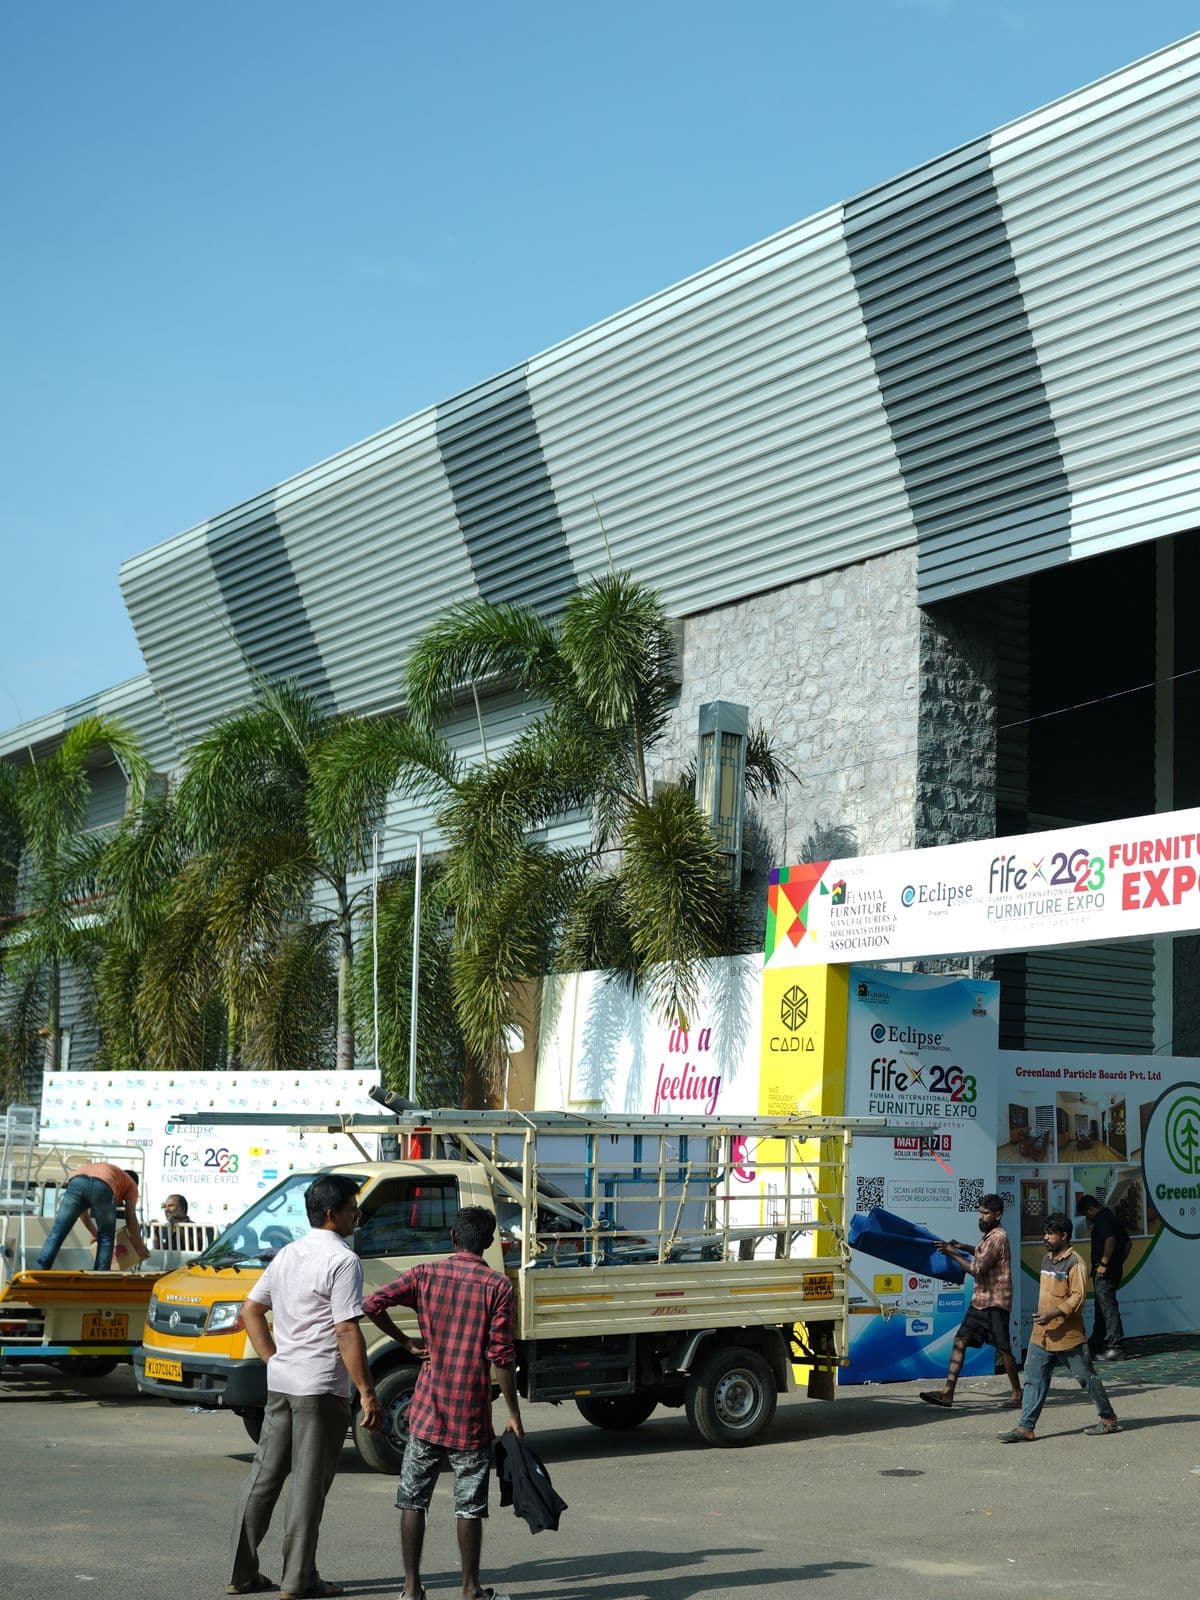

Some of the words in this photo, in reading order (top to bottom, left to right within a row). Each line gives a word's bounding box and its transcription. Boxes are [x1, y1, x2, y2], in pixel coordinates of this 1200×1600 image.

[989, 855, 1027, 894] fife
[1050, 848, 1105, 893] 2023
[918, 882, 973, 907] Eclipse
[831, 902, 888, 918] FURNITURE
[987, 898, 1062, 920] FURNITURE
[1068, 893, 1105, 911] EXPO
[828, 935, 890, 950] ASSOCIATION
[697, 1027, 711, 1052] a
[769, 1036, 815, 1052] CADIA
[888, 1026, 941, 1049] Eclipse
[871, 1057, 908, 1091] fife
[929, 1065, 977, 1103] 2023
[1016, 1067, 1061, 1078] Greenland
[1064, 1068, 1096, 1079] Particle
[1098, 1070, 1127, 1080] Boards
[1129, 1071, 1145, 1080] Pvt.
[1148, 1071, 1161, 1080] Ltd
[653, 1062, 721, 1115] feeling
[898, 1093, 949, 1102] INTERNATIONAL
[869, 1100, 940, 1116] FURNITURE
[945, 1104, 977, 1117] EXPO
[177, 1124, 214, 1138] Eclipse
[897, 1136, 915, 1147] MAY
[163, 1145, 189, 1167] fife
[204, 1148, 239, 1174] 2023
[161, 1174, 211, 1184] FURNITURE
[214, 1174, 239, 1184] EXPO
